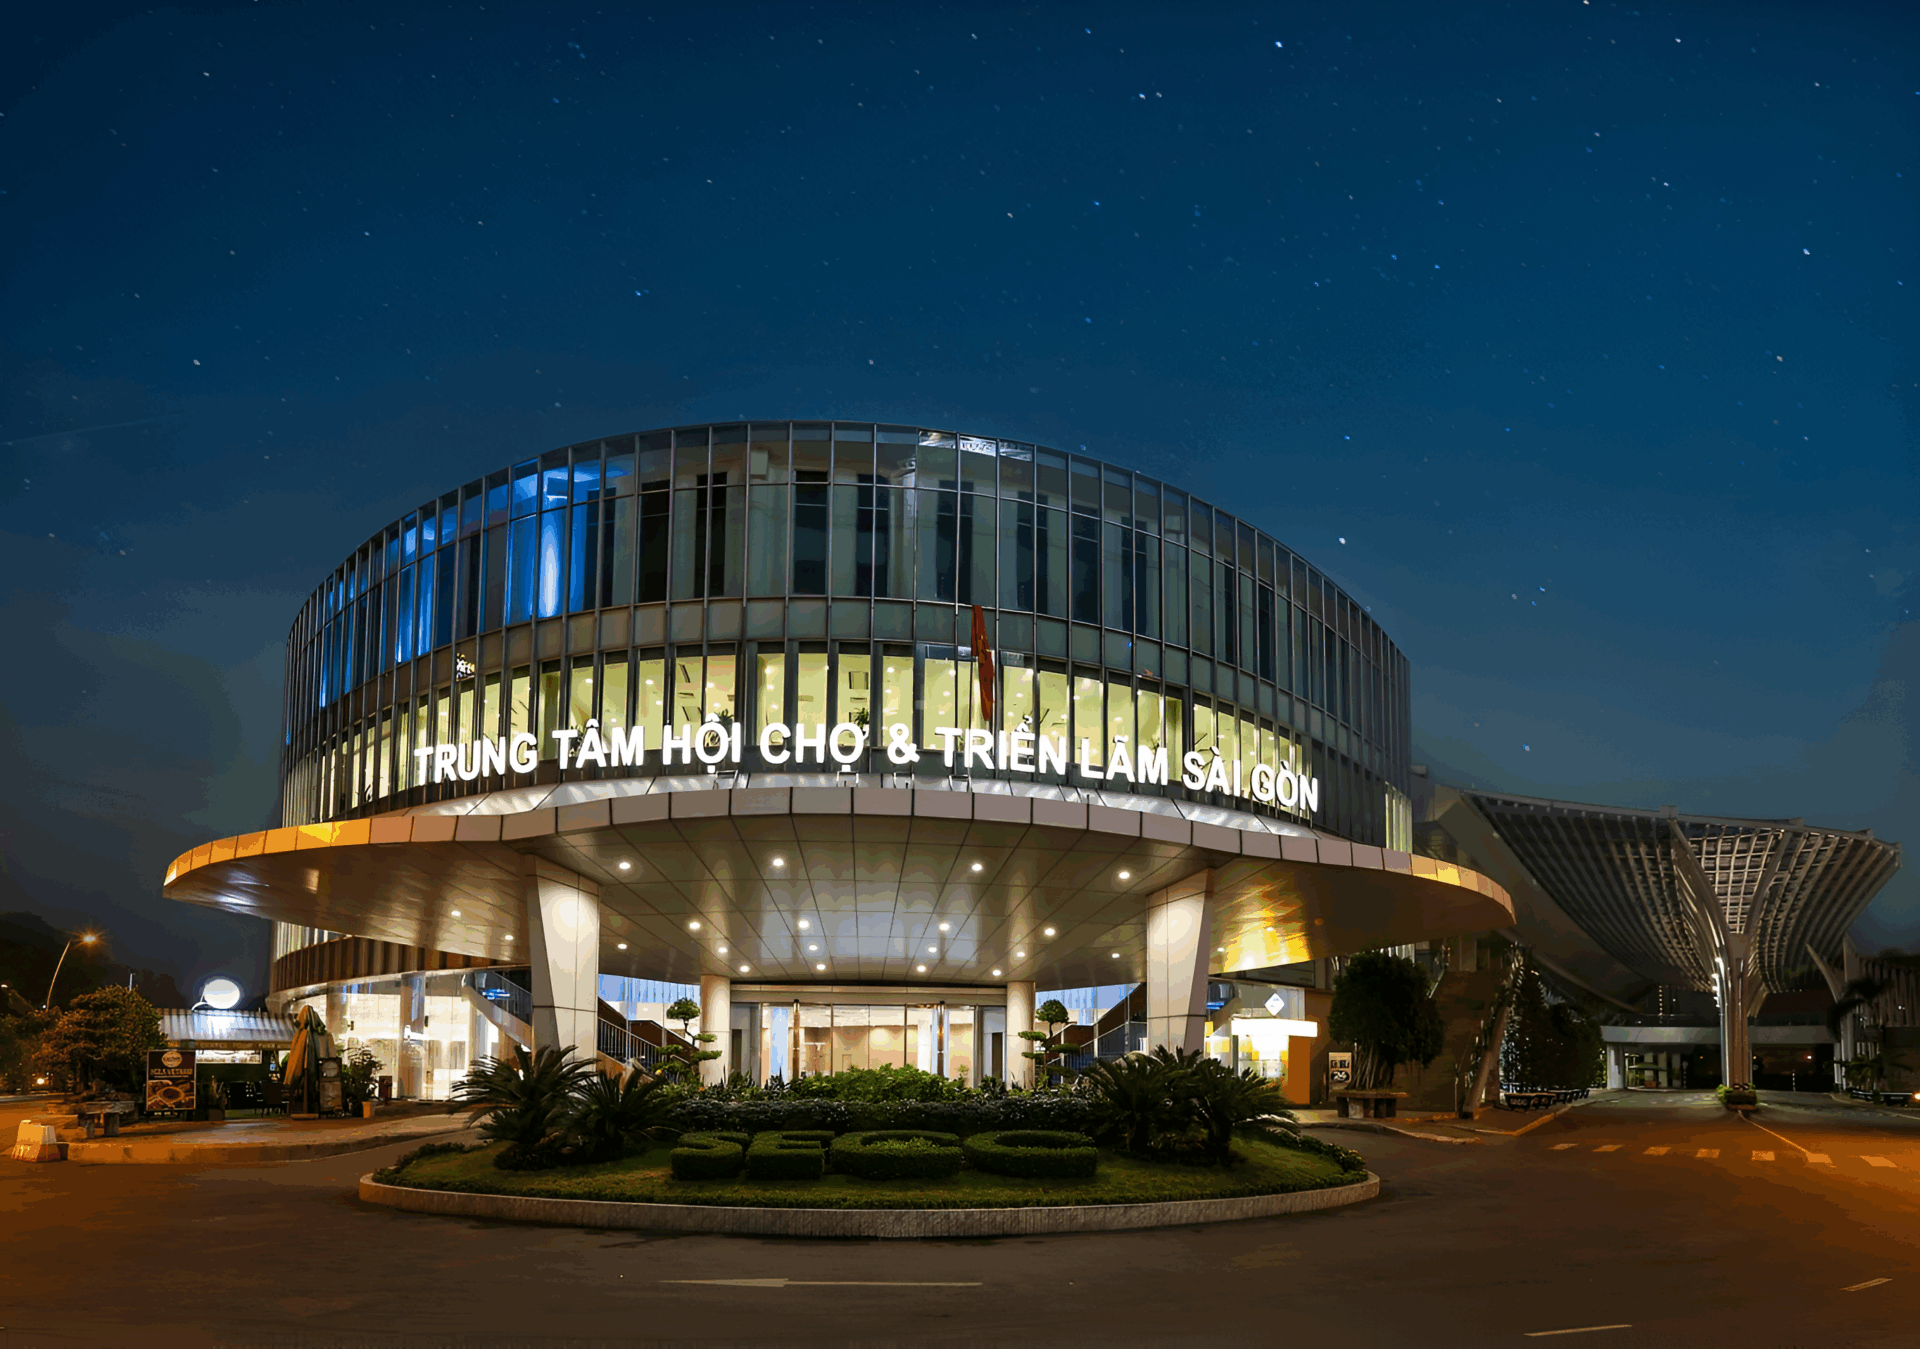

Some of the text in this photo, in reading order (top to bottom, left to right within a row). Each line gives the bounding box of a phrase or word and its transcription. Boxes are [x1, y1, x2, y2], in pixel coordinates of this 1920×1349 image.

[414, 713, 1319, 813] TRUNG TÂM HỘI CHỢ & TRIỂN LÃM SÀI GÒN
